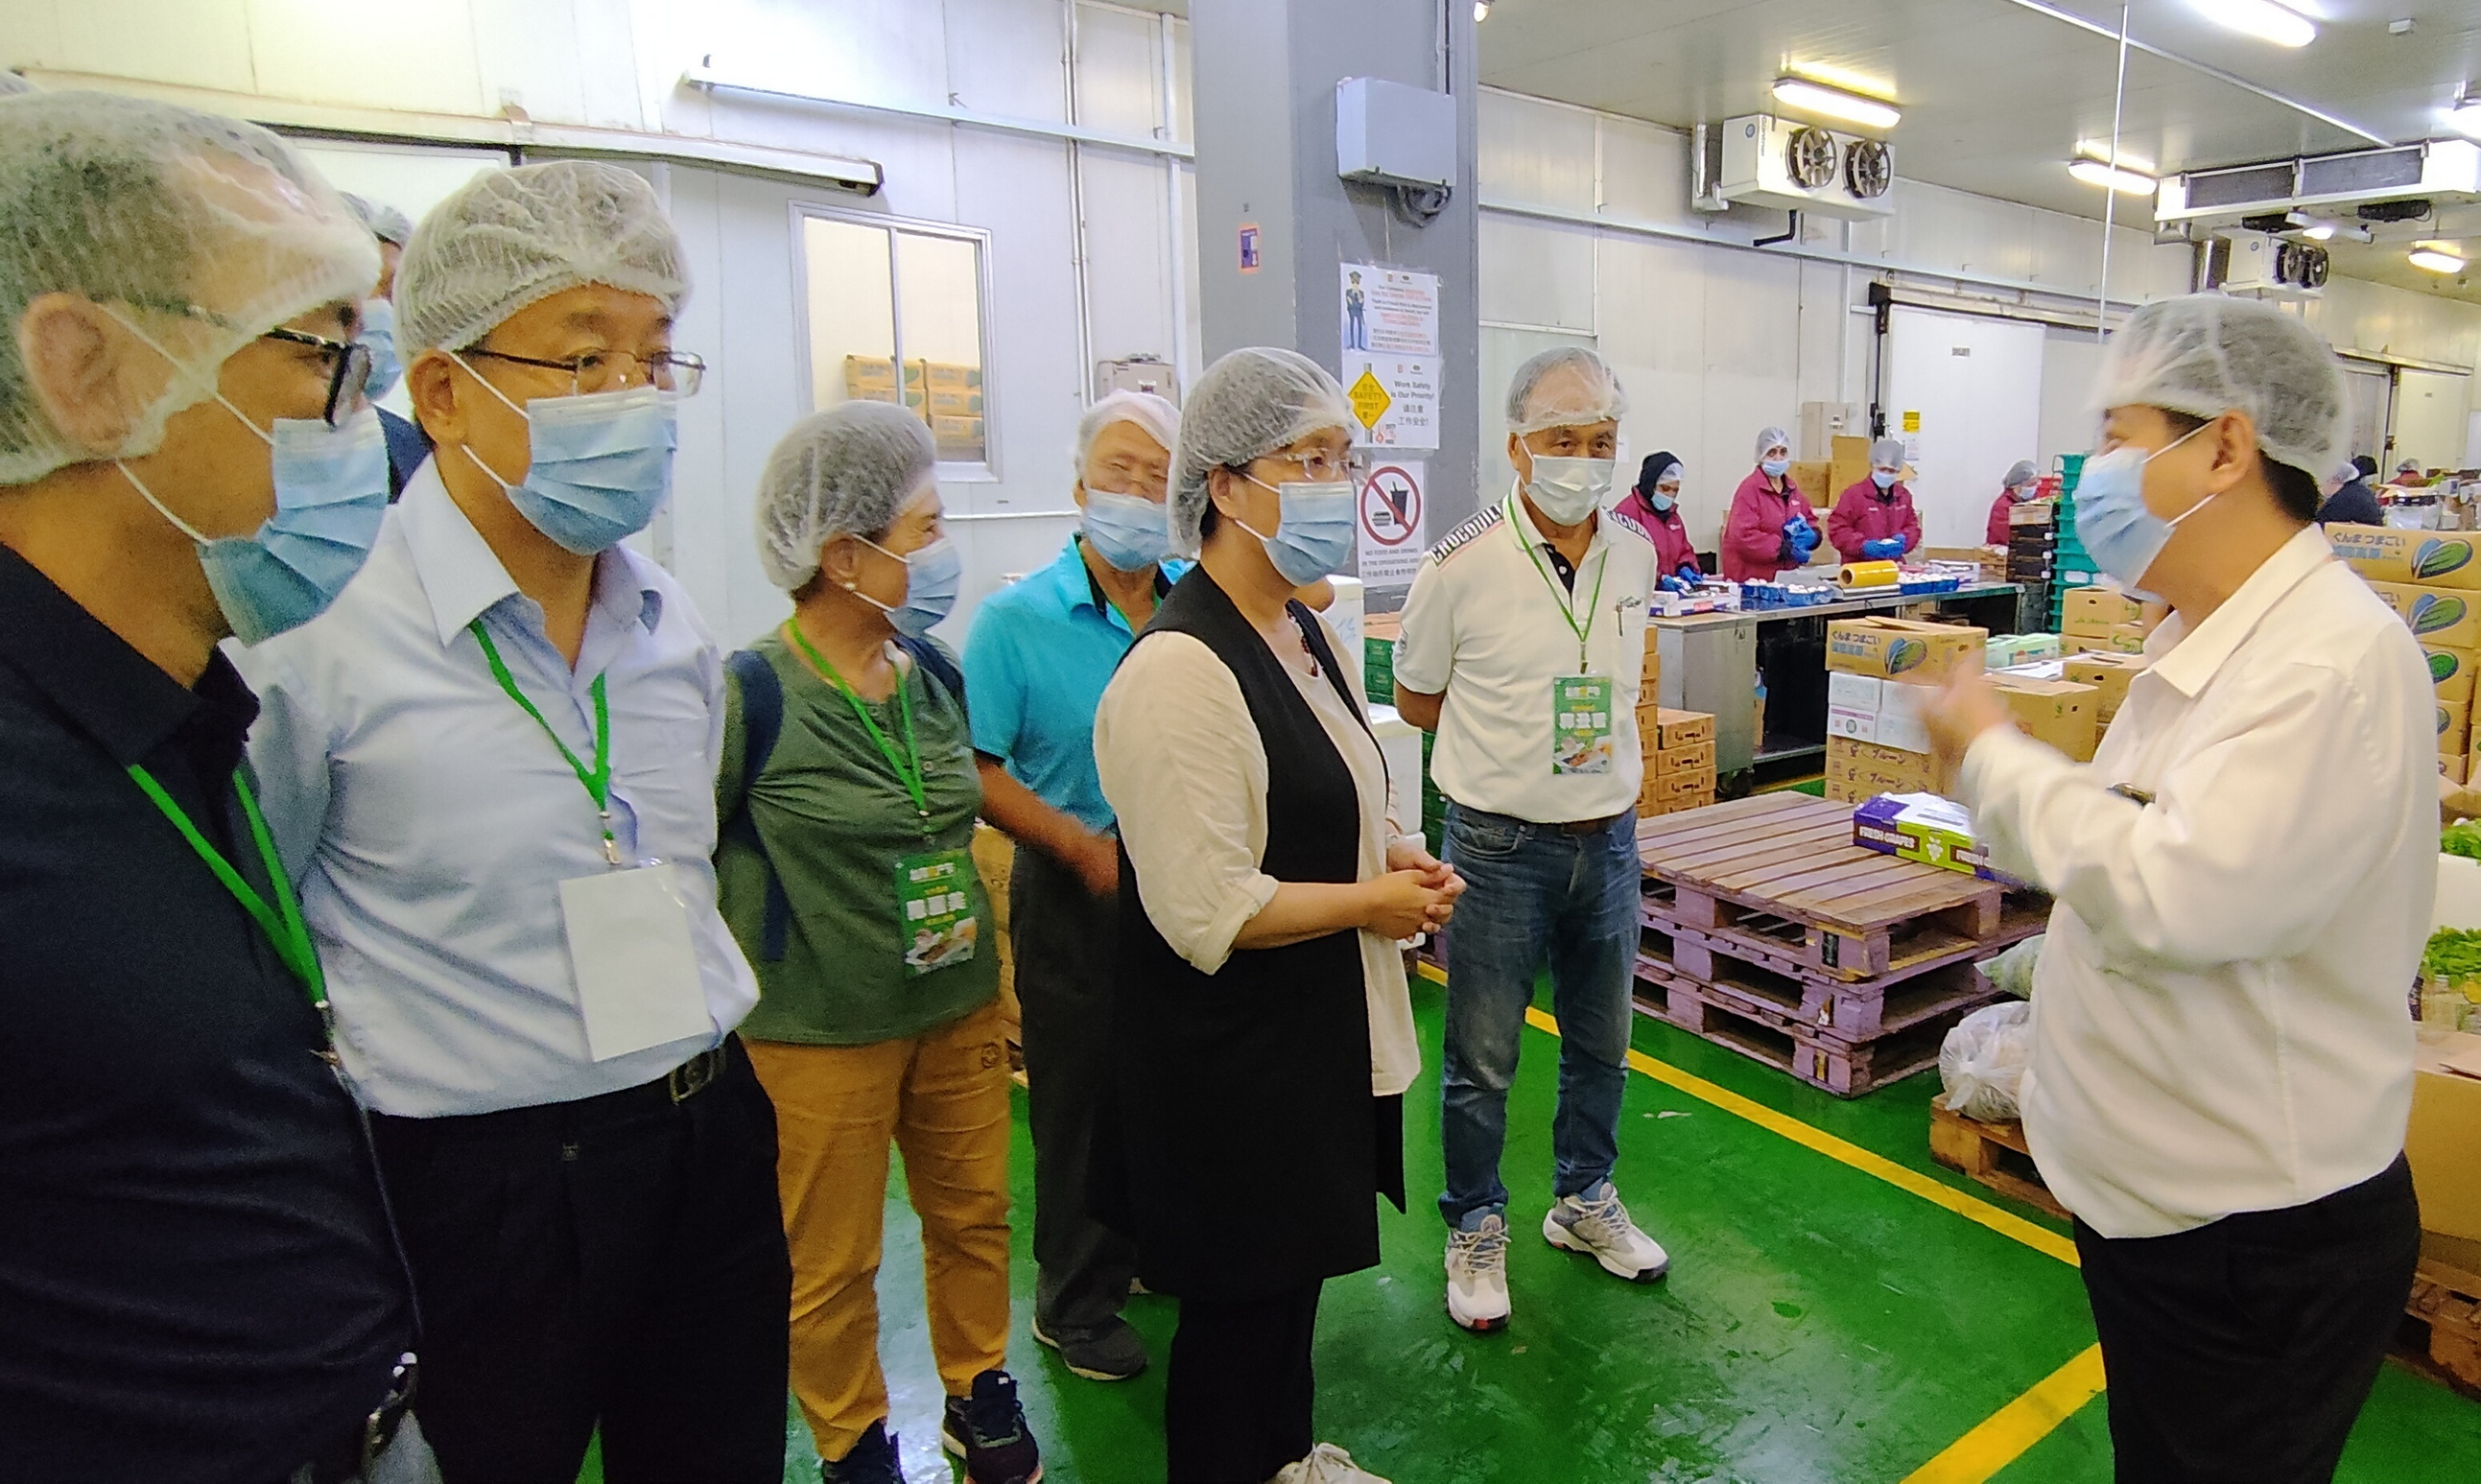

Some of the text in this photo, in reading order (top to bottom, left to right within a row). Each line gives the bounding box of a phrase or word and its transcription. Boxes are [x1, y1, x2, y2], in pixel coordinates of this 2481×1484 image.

[1412, 381, 1430, 390] Safety
[1354, 391, 1382, 400] SAFETY
[1859, 826, 1915, 849] FRESH GRAPES
